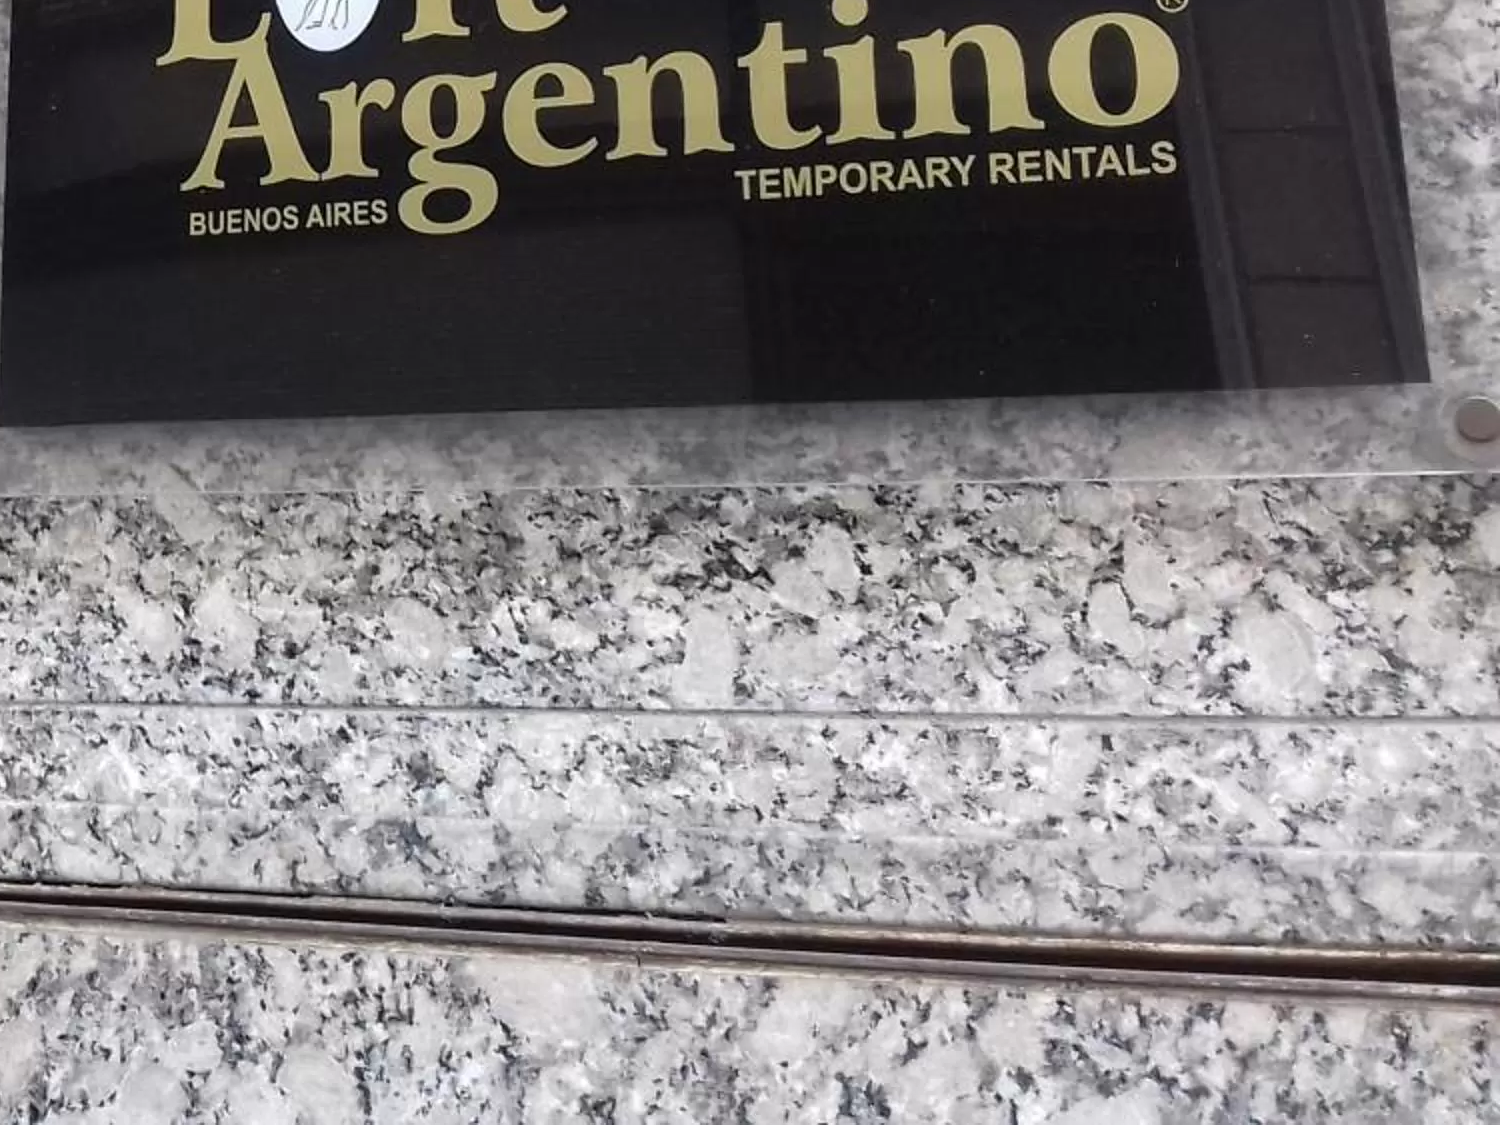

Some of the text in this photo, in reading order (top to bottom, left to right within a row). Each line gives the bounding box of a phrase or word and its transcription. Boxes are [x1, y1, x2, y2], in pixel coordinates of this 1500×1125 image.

[735, 140, 1178, 200] TEMPORARY RENTALS
[189, 199, 389, 236] BUENOS AIRES
